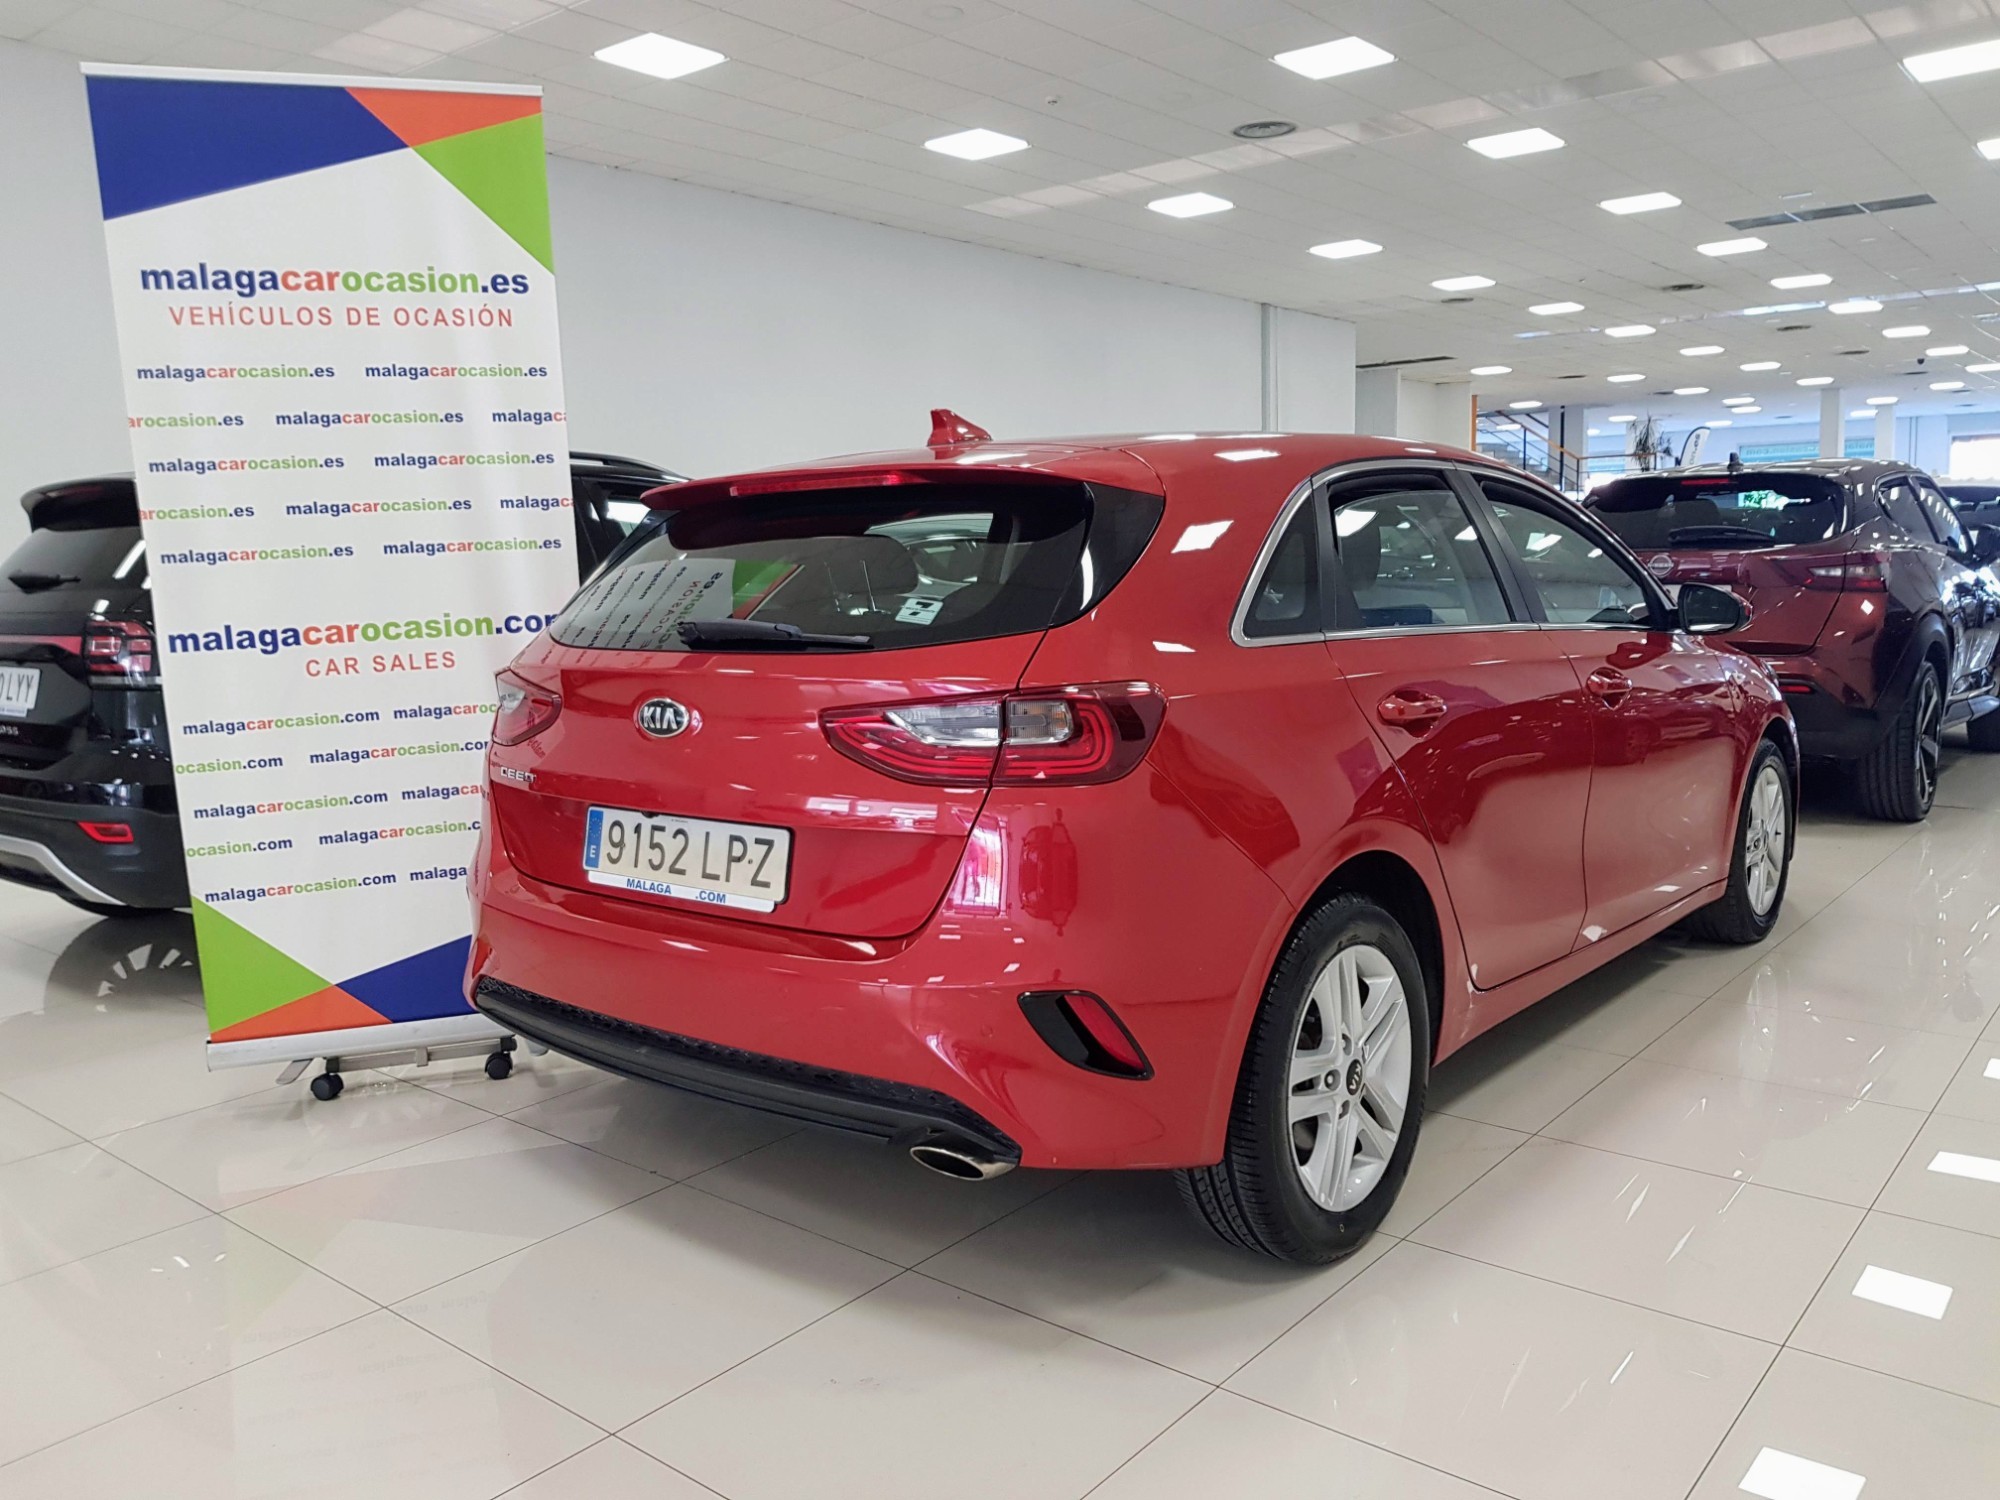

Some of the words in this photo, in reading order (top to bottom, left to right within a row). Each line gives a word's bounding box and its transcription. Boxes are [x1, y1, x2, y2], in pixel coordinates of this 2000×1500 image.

[141, 263, 530, 298] malagacarocasion.es
[169, 302, 333, 327] VEHÍCULOS
[346, 306, 381, 327] DE
[394, 303, 514, 328] OCASIÓN
[137, 363, 335, 383] malagacarocasion.es
[365, 362, 548, 381] malagacarocasion.es
[275, 409, 464, 428] malagacarocasion.es
[148, 455, 345, 475] malagacarocasion.es
[374, 450, 555, 470] malagacarocasion.es
[286, 496, 472, 517] malagacarocasion.es
[160, 542, 354, 566] malagacarocasion.es
[384, 536, 562, 556] malagacarocasion.es
[306, 656, 361, 678] CAR
[373, 650, 456, 674] SALES
[183, 709, 380, 736] malagacarocasion.com
[643, 706, 678, 729] KIA
[175, 754, 283, 775] ocasion.com
[194, 790, 388, 819] malagacarocasion.com
[319, 820, 481, 846] malagacarocasion.c
[186, 838, 293, 858] ocasion.com
[589, 845, 597, 858] E
[606, 819, 690, 876] 9152
[701, 831, 775, 889] LPZ
[410, 866, 468, 882] malaga
[205, 873, 397, 903] malagacarocasion.com
[626, 878, 672, 895] MALAGA
[695, 890, 726, 904] .COM
